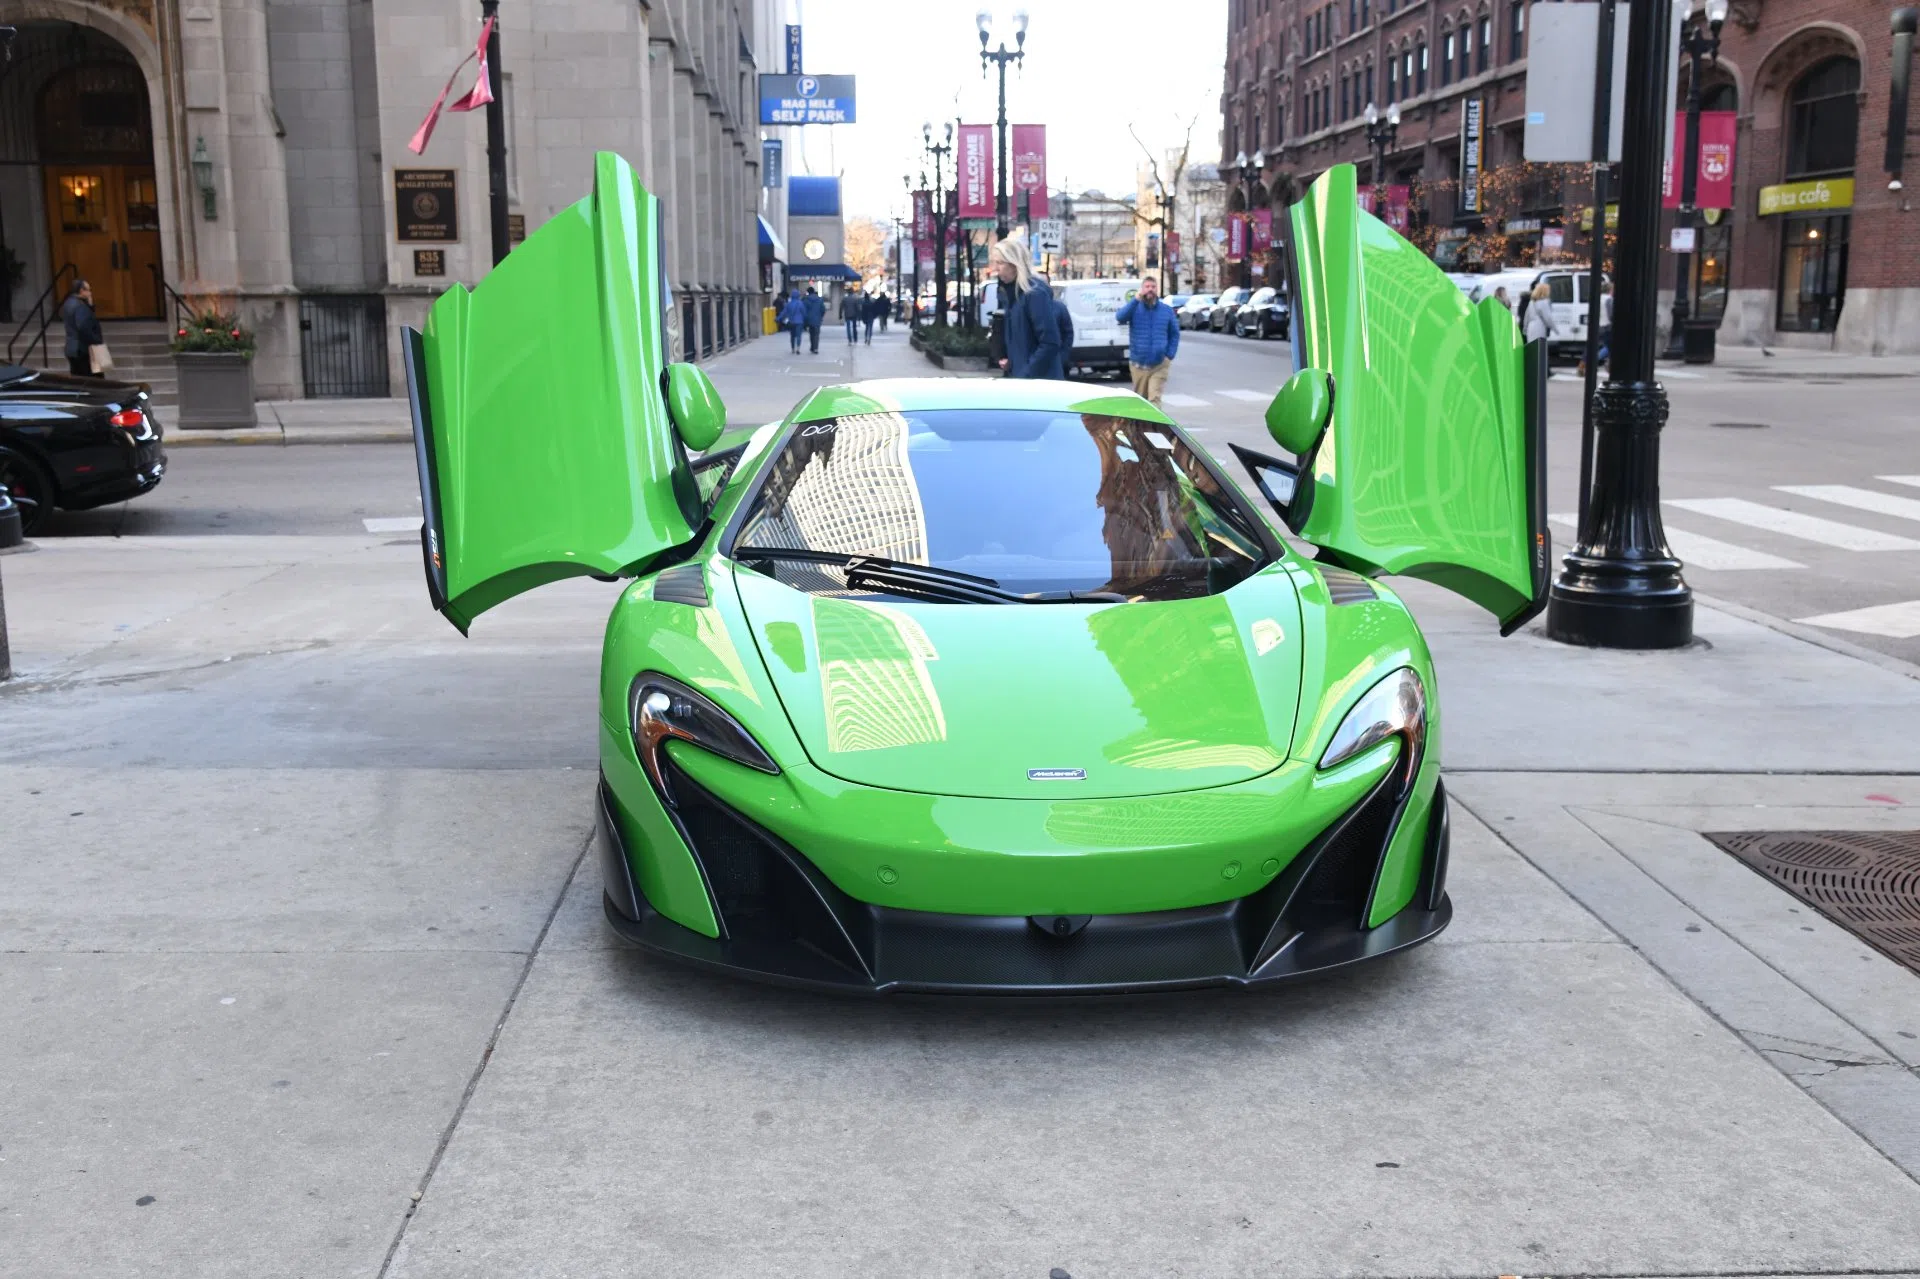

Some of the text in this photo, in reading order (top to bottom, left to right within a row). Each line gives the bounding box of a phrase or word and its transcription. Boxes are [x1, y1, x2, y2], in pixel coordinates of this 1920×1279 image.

[802, 78, 815, 94] P
[781, 99, 836, 109] MAG MILE
[771, 110, 845, 122] SELF PARK
[1468, 100, 1480, 137] BAGELS
[966, 133, 979, 206] WELCOME
[1799, 182, 1830, 204] café
[1041, 222, 1060, 230] ONE
[1041, 232, 1060, 240] WAY
[419, 251, 439, 262] 835
